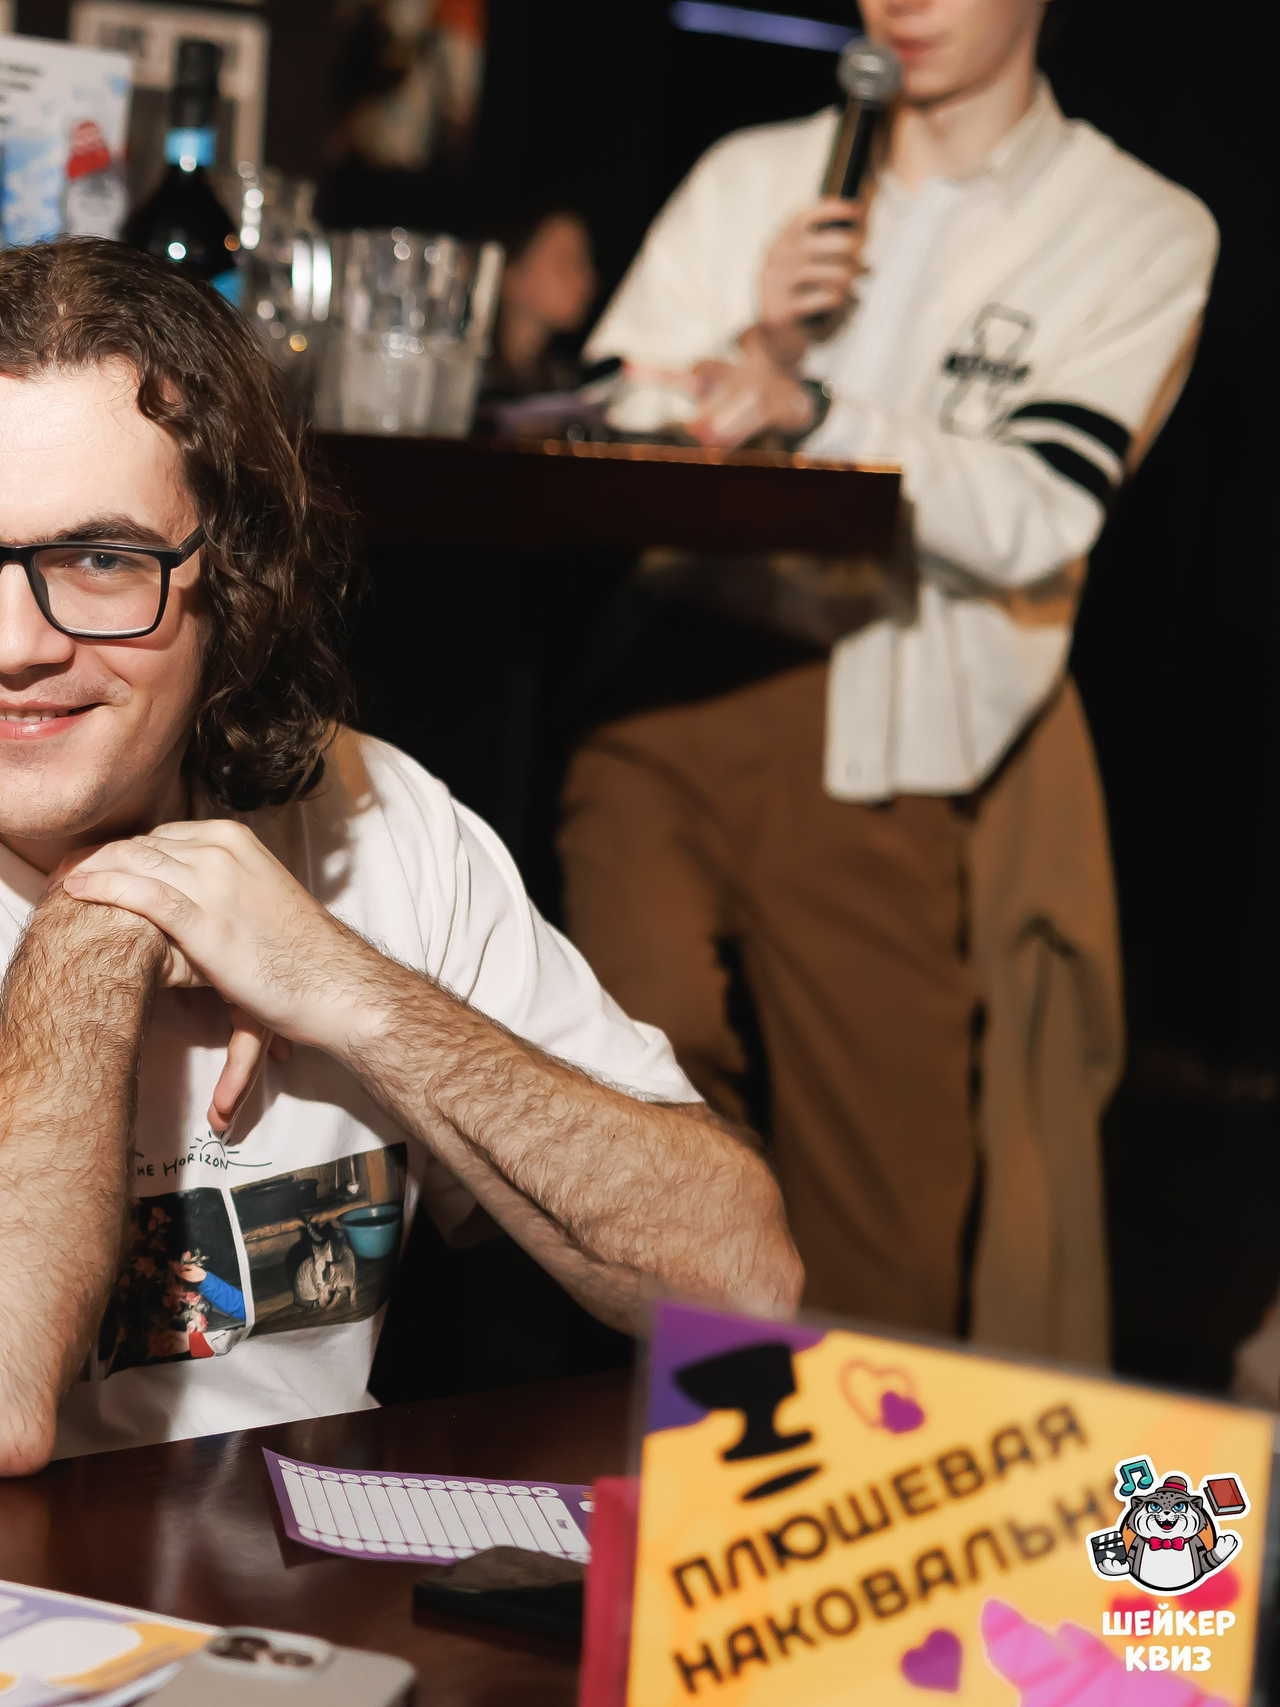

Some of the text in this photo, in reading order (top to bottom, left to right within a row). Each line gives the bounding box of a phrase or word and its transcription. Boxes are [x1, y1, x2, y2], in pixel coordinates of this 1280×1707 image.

[137, 1153, 229, 1177] HE HORIZON
[669, 1401, 1092, 1609] ПЛЮШЕВАЯ
[671, 1476, 1122, 1695] НАКОВАЛЬН
